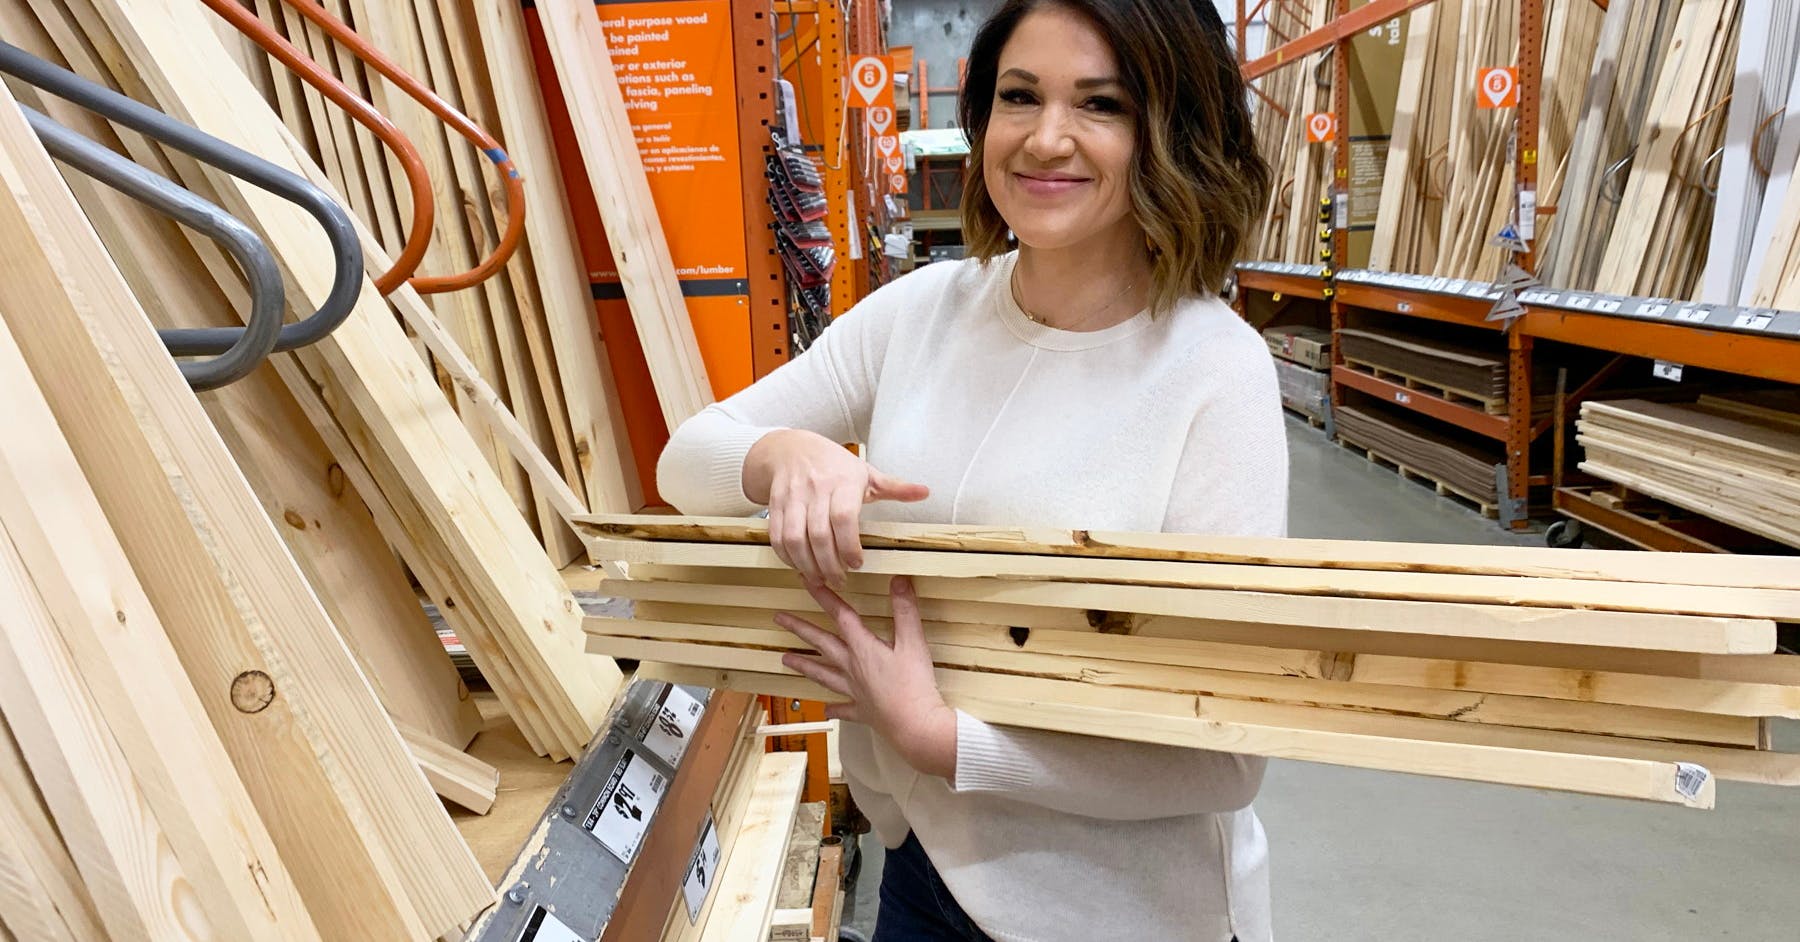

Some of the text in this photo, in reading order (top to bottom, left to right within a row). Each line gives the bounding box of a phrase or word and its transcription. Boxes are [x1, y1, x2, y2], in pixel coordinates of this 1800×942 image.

[628, 18, 672, 29] purpose
[676, 13, 708, 25] wood
[610, 31, 669, 45] be painted
[608, 45, 639, 56] ained
[628, 62, 640, 71] or
[643, 59, 687, 71] exterior
[618, 72, 695, 84] ations such as
[864, 71, 875, 85] 6
[664, 83, 713, 97] paneling
[642, 122, 672, 132] general
[676, 264, 734, 276] com/lumber
